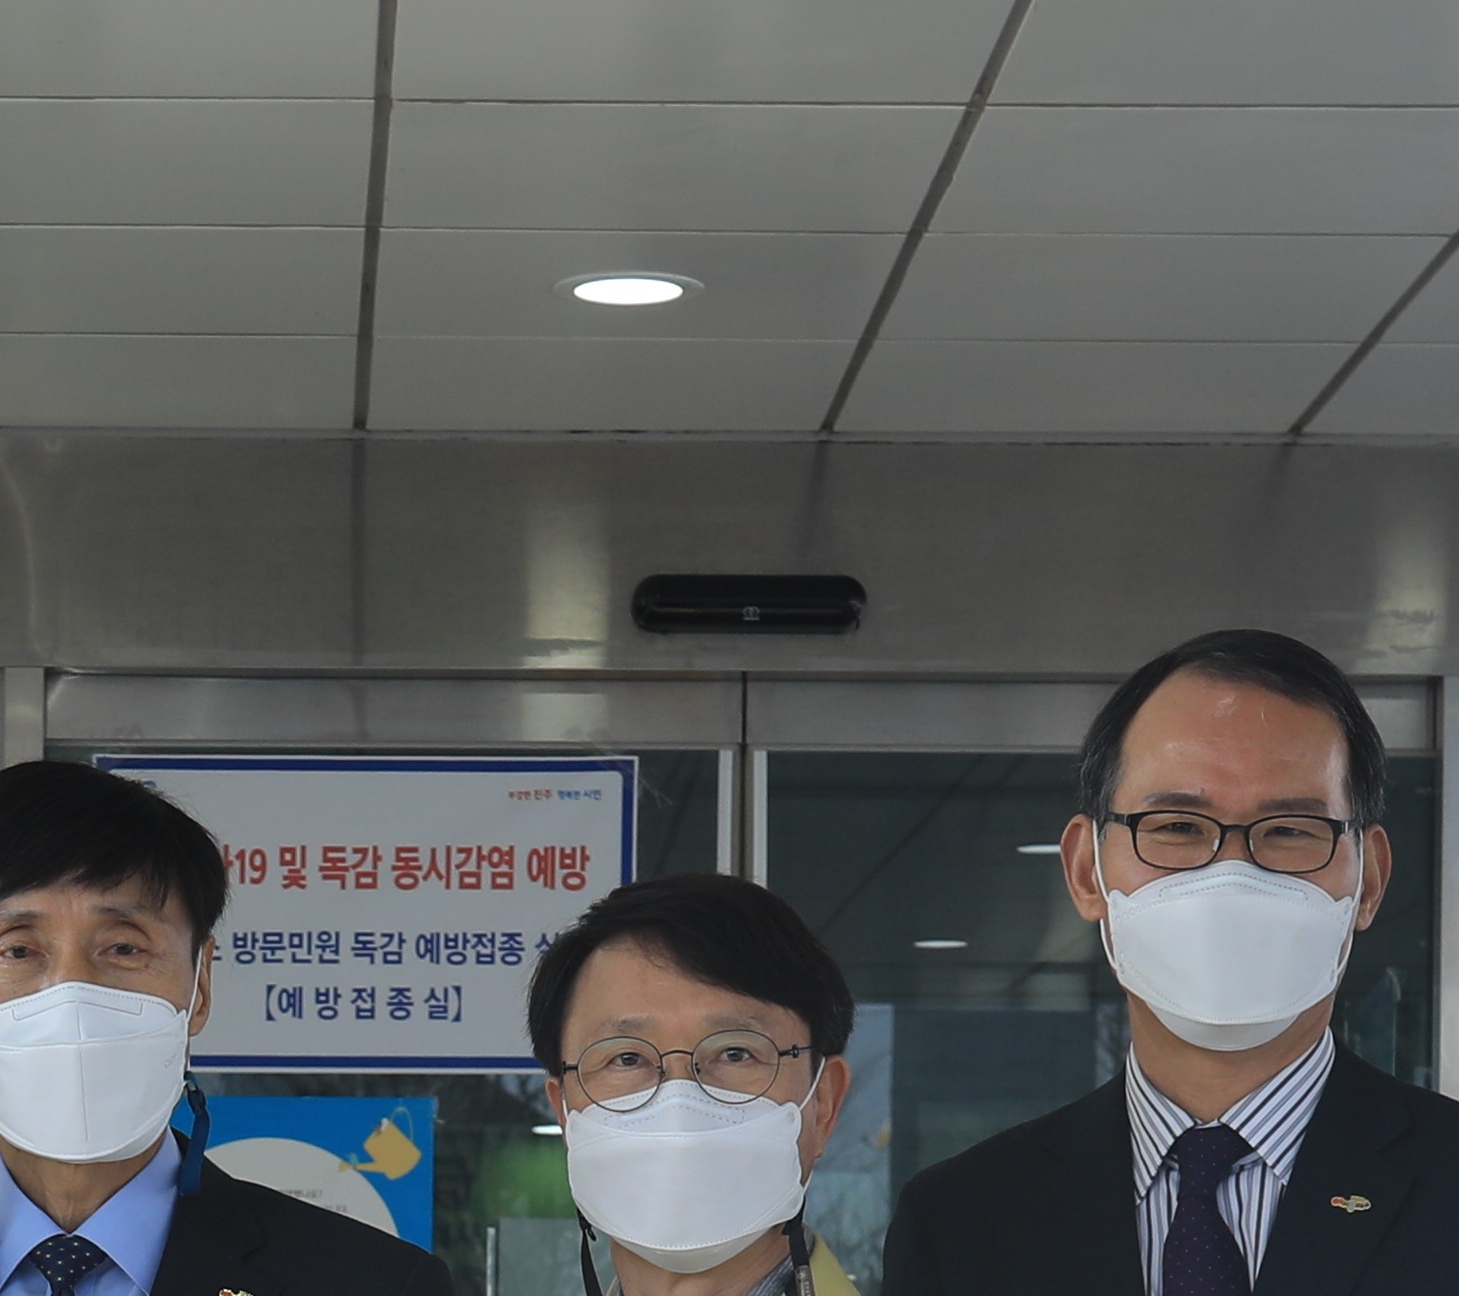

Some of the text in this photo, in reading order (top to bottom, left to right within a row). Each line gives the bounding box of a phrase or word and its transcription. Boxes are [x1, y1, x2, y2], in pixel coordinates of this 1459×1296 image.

[279, 845, 309, 891] 및
[318, 845, 382, 891] 독감
[391, 845, 516, 892] 동시감염
[527, 845, 591, 892] 예방
[232, 931, 342, 966] 방문민원
[351, 932, 406, 966] 독감
[415, 931, 525, 966] 예방접종
